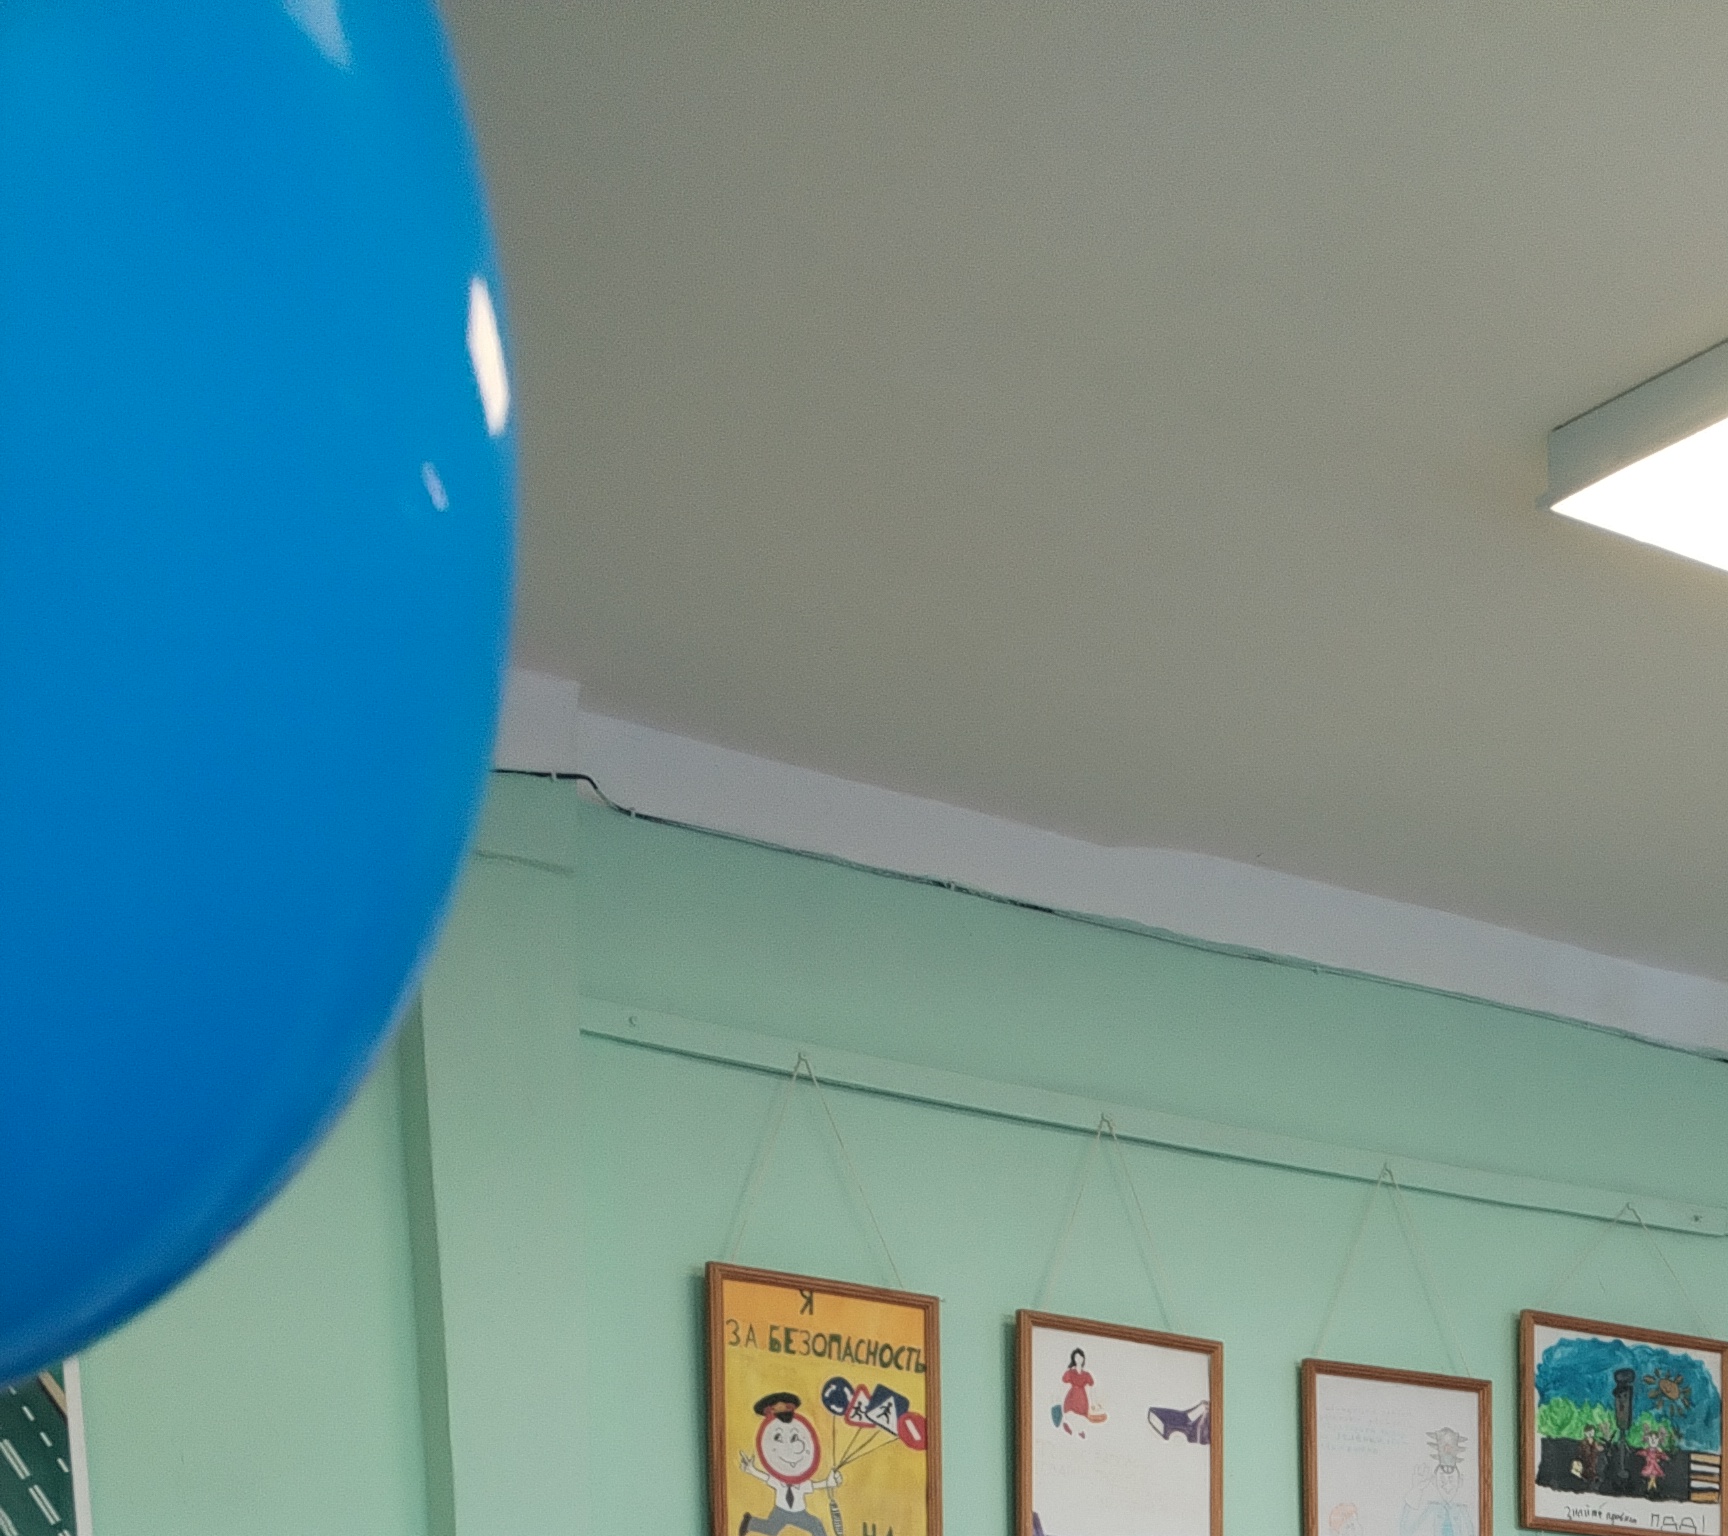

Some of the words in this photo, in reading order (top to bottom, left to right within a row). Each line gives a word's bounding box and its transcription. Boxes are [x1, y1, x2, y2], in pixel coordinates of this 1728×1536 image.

[800, 1289, 814, 1316] Я
[725, 1318, 758, 1348] ЗА
[768, 1324, 927, 1373] БЕЗОПАСНОСТЬ
